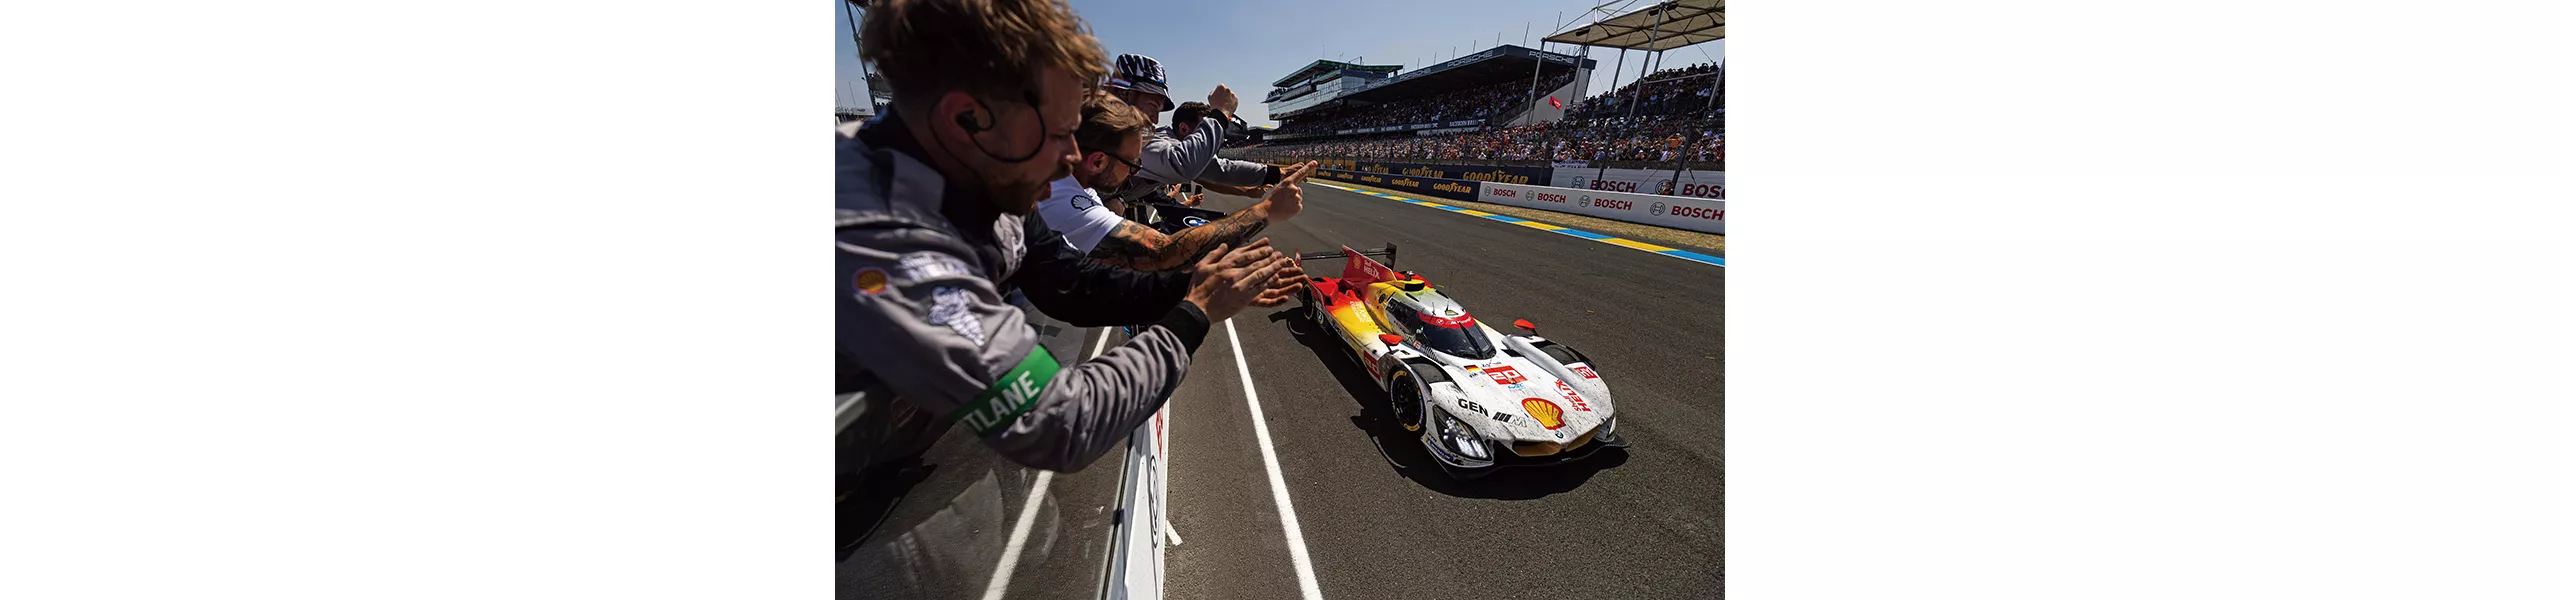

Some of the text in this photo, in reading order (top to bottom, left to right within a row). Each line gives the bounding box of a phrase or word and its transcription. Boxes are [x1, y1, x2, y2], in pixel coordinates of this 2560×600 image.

[1447, 51, 1493, 68] PORSCHE
[1528, 50, 1575, 65] PORSCHE
[1391, 177, 1420, 188] GOODYEAR
[1463, 169, 1529, 184] GOODYEAR
[1433, 181, 1472, 194] GOODYEAR
[1493, 187, 1516, 198] BOSCH
[1589, 179, 1637, 193] BOSCH
[1537, 192, 1567, 204] BOSCH
[1594, 198, 1633, 211] BOSCH
[1671, 205, 1725, 221] BOSCH
[1488, 369, 1521, 380] 20
[1555, 378, 1592, 412] HELIX
[1458, 398, 1489, 417] GEN
